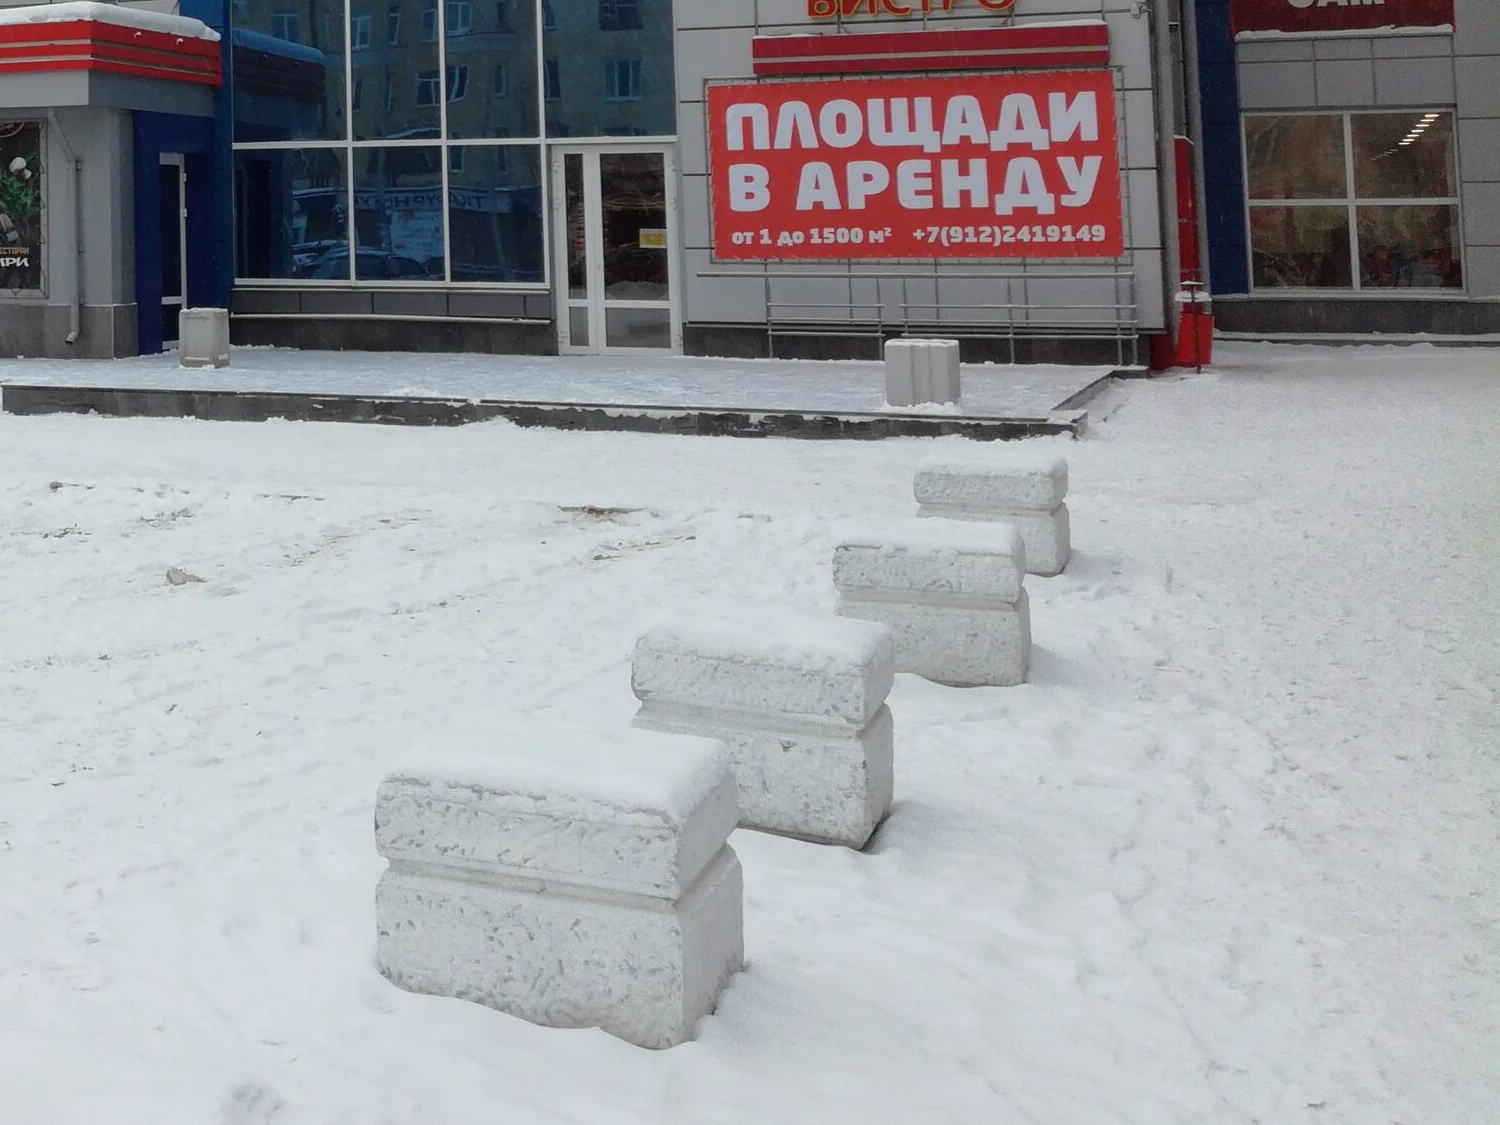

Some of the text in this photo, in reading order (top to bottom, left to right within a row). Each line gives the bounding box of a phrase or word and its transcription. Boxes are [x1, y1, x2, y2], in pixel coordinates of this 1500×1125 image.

[725, 91, 1099, 153] ПЛОЩАДИ
[728, 155, 1102, 216] В АРЕНДУ
[732, 231, 755, 245] от
[759, 228, 772, 245] 1
[777, 230, 805, 246] до
[809, 227, 863, 245] 1500
[912, 224, 1106, 246] +7(912)2419149
